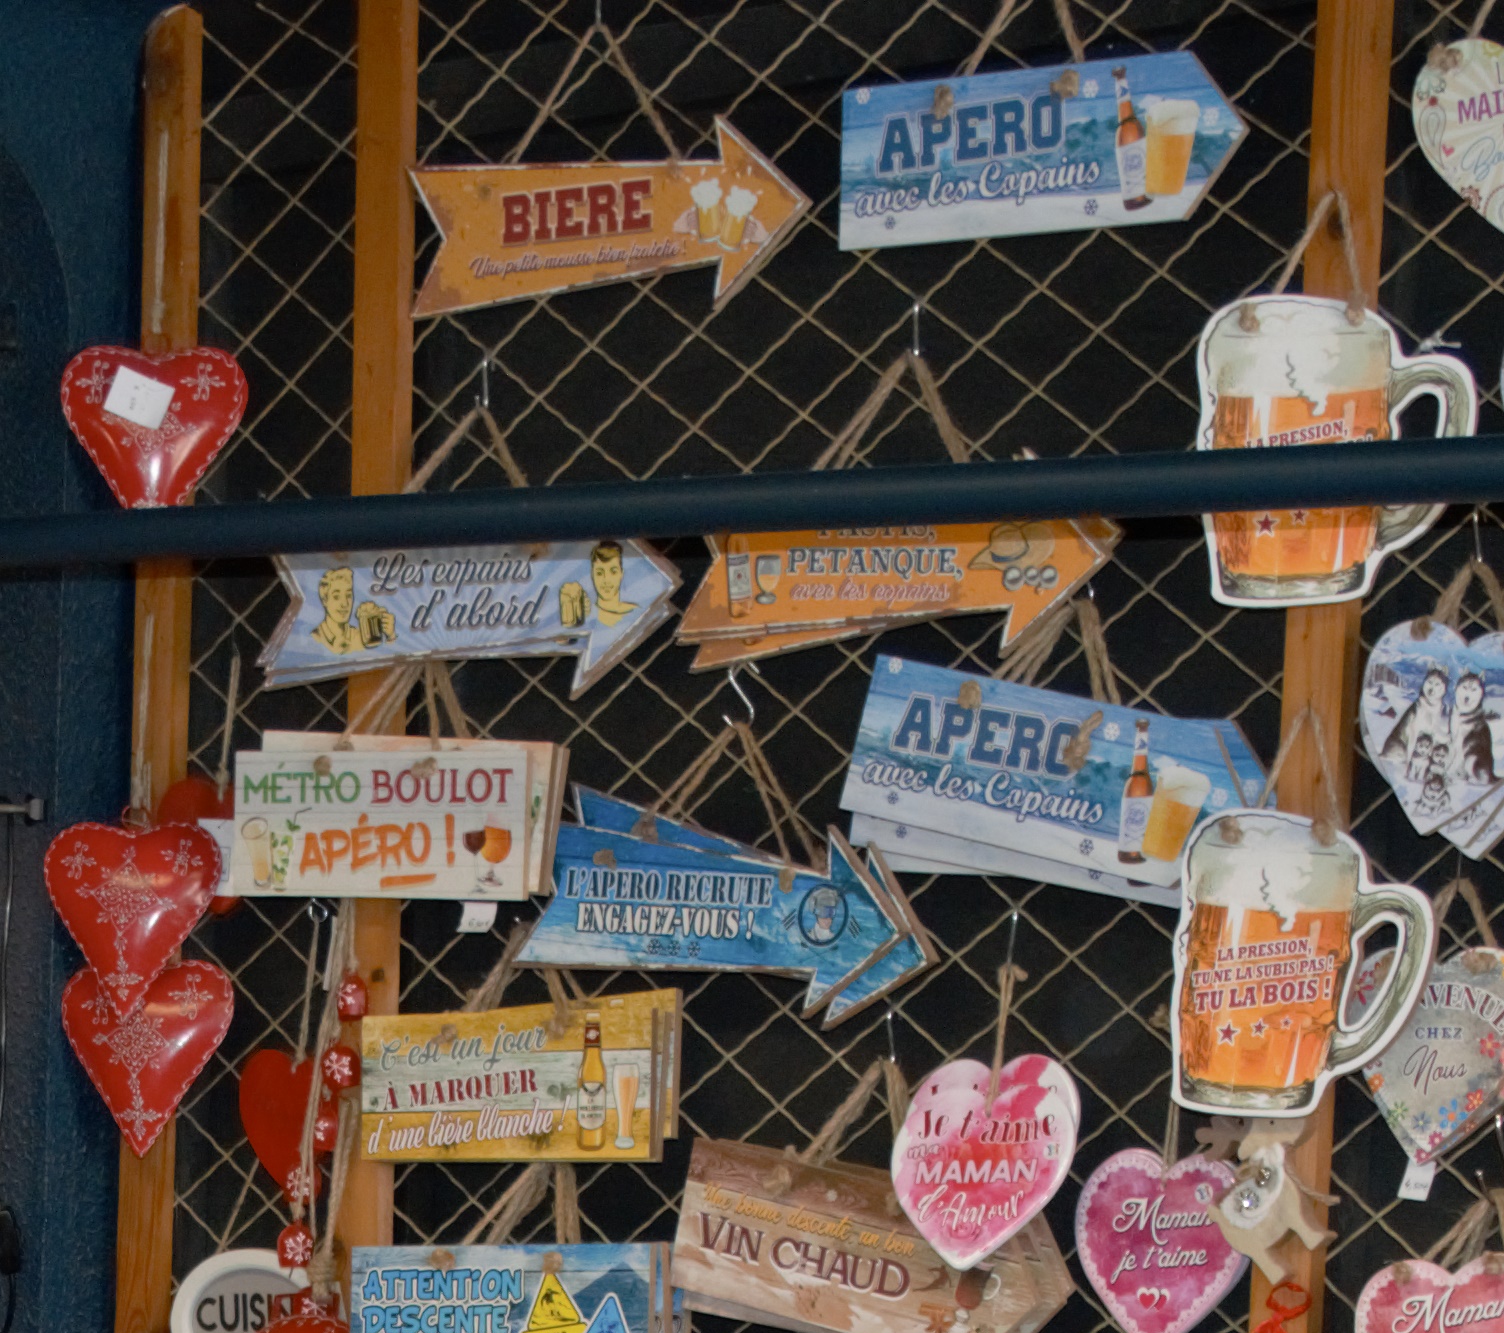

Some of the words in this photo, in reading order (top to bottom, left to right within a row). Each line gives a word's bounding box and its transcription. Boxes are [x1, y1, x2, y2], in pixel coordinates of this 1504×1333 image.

[876, 91, 1065, 178] APERO
[854, 186, 920, 218] avec
[928, 172, 971, 207] les
[978, 158, 1101, 206] Copains
[501, 176, 653, 247] BIERE
[372, 552, 424, 590] Les
[431, 549, 534, 589] copains
[786, 547, 964, 582] PETANQUE,
[410, 594, 542, 633] d'abord
[242, 762, 362, 805] MÉTRO
[371, 767, 514, 806] BOULOT
[861, 758, 928, 795] avec
[932, 762, 978, 802] les
[980, 770, 1106, 825] Copains
[298, 815, 433, 879] APÉRO
[564, 866, 664, 902] L'APERO
[670, 872, 773, 908] RECRUTE
[575, 901, 740, 940] ENGAGEZ-VOUS
[1216, 946, 1233, 964] LA
[1235, 963, 1254, 982] LA
[1255, 958, 1295, 979] SUBIS
[1296, 955, 1323, 976] PAS
[1195, 986, 1228, 1012] TU
[1229, 984, 1261, 1009] LA
[1263, 979, 1317, 1007] BOIS
[450, 1038, 486, 1063] un
[490, 1021, 548, 1065] jour
[1415, 1025, 1464, 1040] CHEZ
[406, 1068, 539, 1107] MARQUER
[1403, 1043, 1468, 1095] Nous
[481, 1104, 554, 1141] blanche
[916, 1109, 948, 1141] Je
[958, 1108, 1058, 1147] t'aime
[914, 1157, 1038, 1185] MAMAN
[1112, 1196, 1216, 1245] Maman
[697, 1212, 760, 1263] VIN
[769, 1238, 912, 1301] CHAUD
[1109, 1249, 1136, 1284] je
[1142, 1244, 1208, 1270] t'aime
